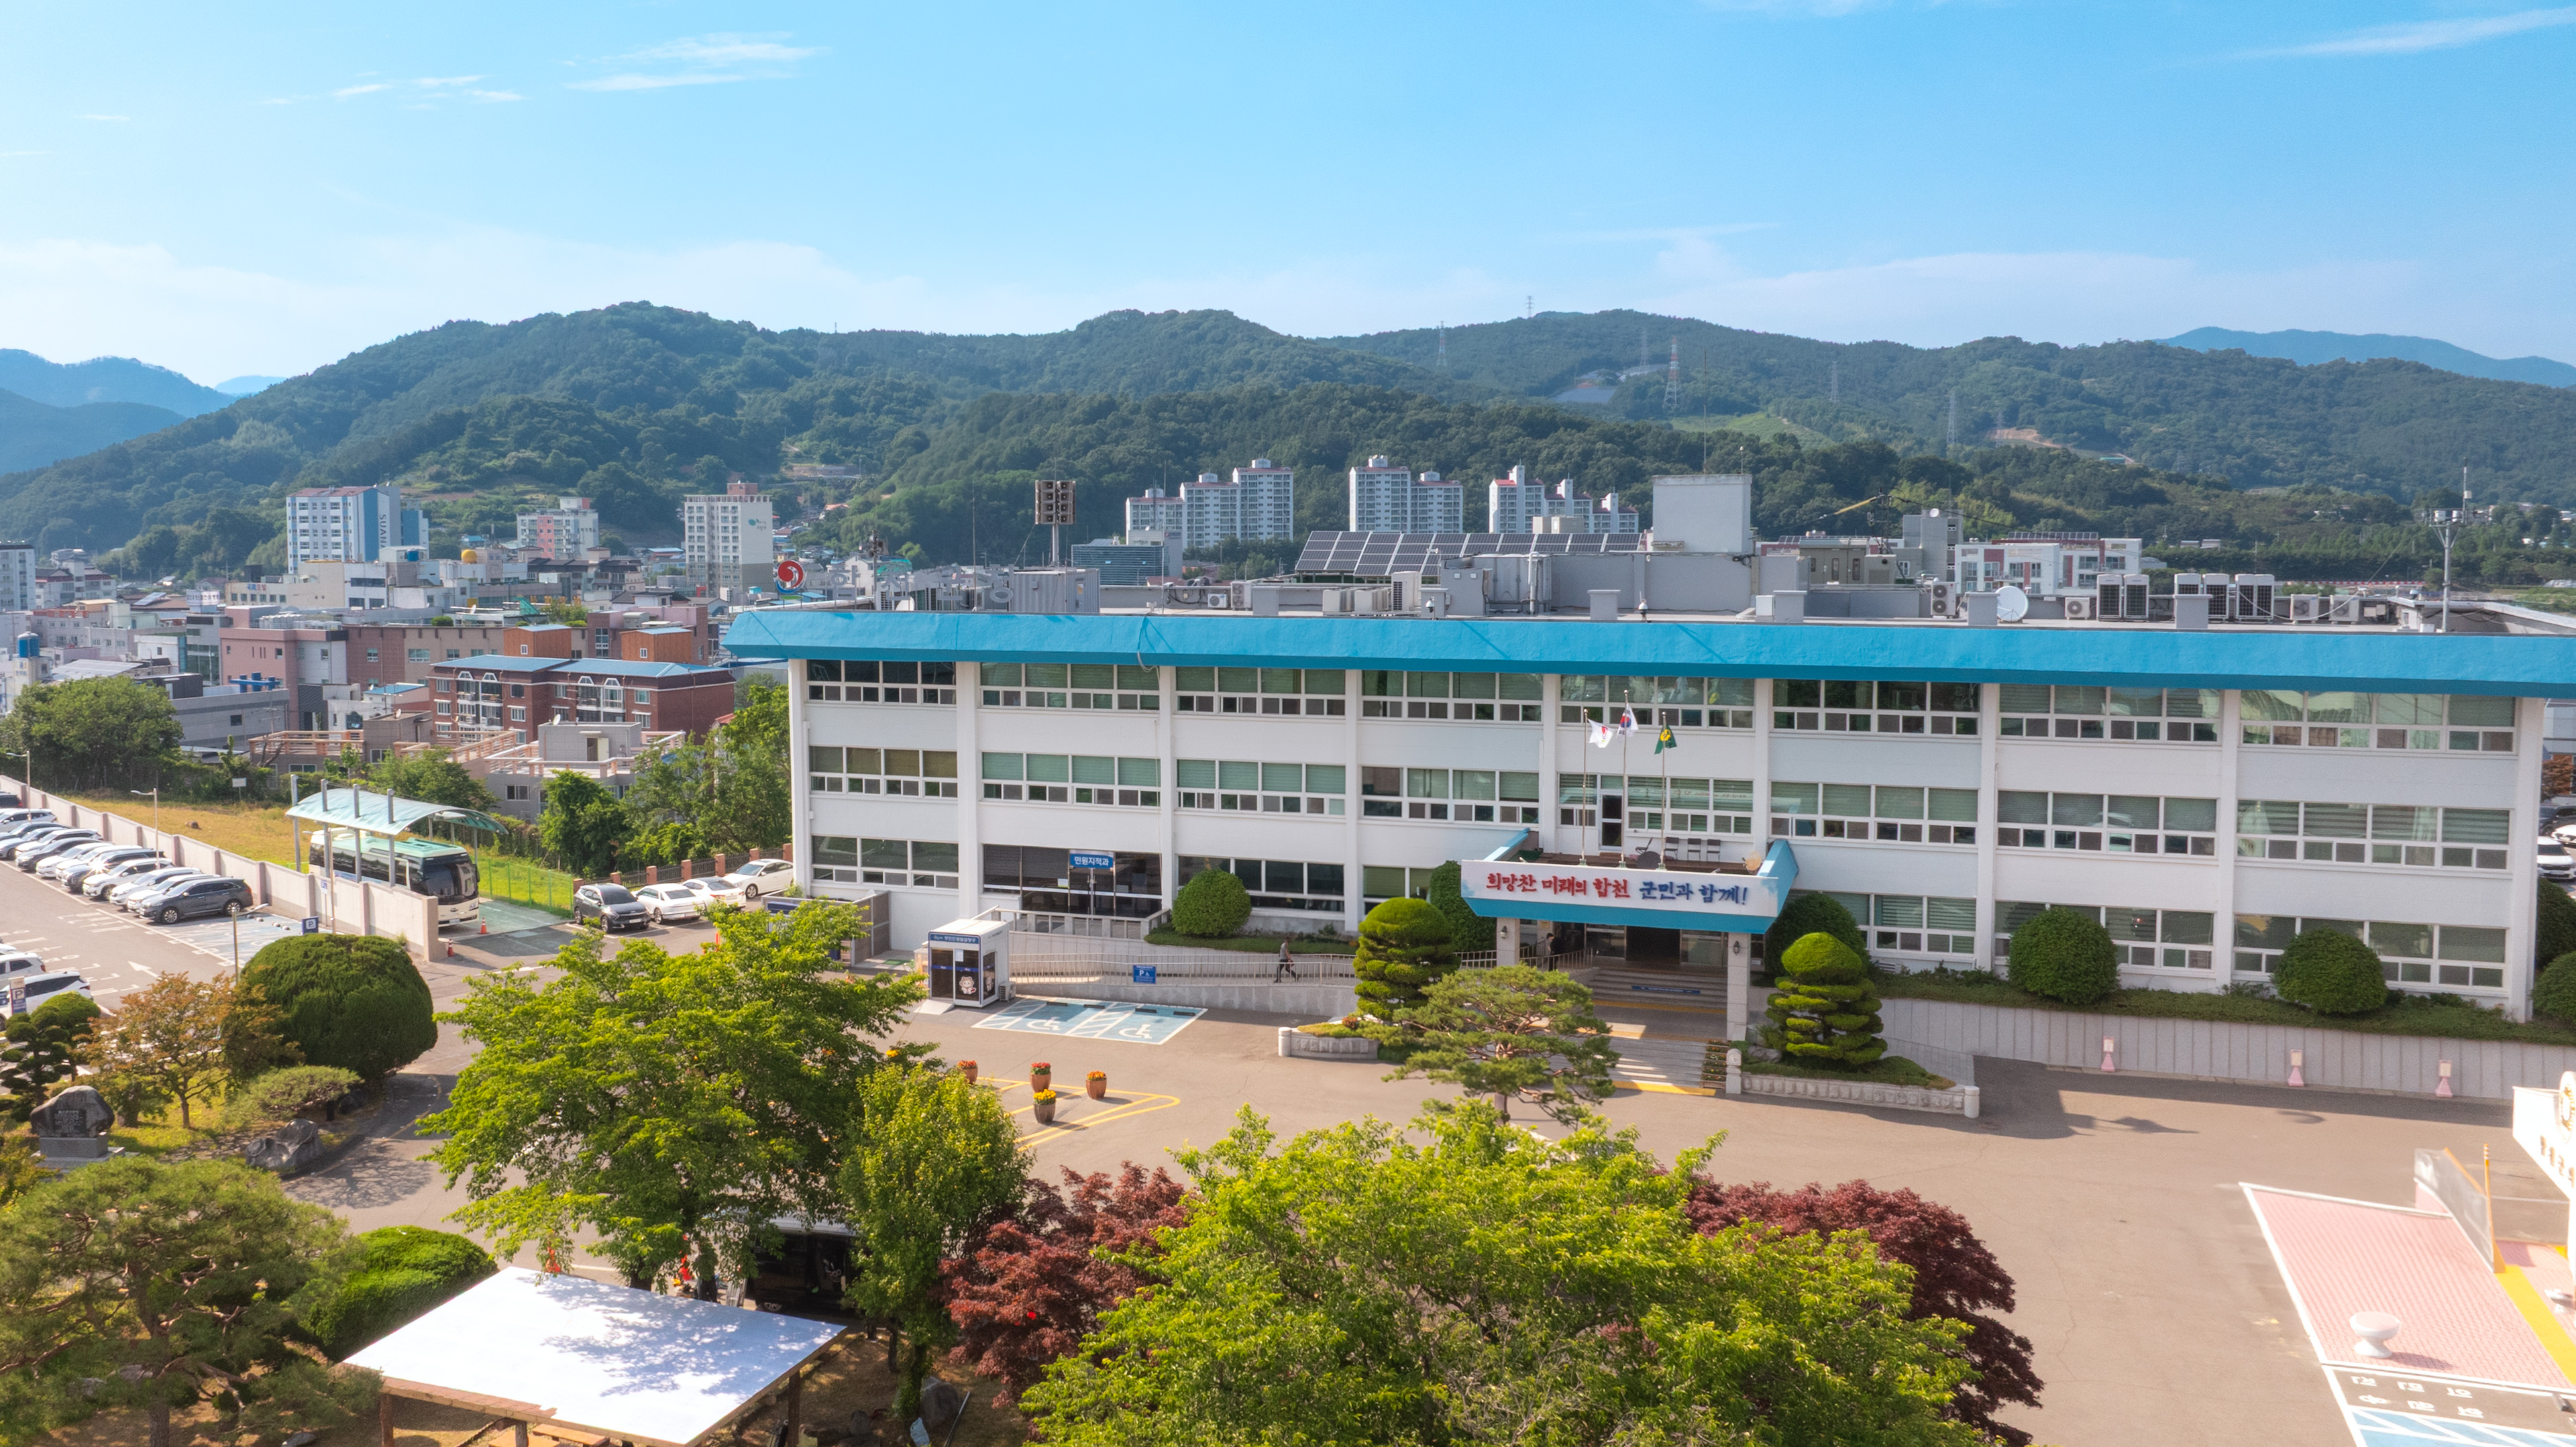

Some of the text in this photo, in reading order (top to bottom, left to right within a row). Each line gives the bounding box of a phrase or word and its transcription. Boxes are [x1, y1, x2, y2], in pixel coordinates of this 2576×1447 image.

[1074, 856, 1109, 866] 민원지적과
[1487, 872, 1749, 905] 희망찬 미래의 합천 군민과 함께!
[15, 989, 23, 1000] P
